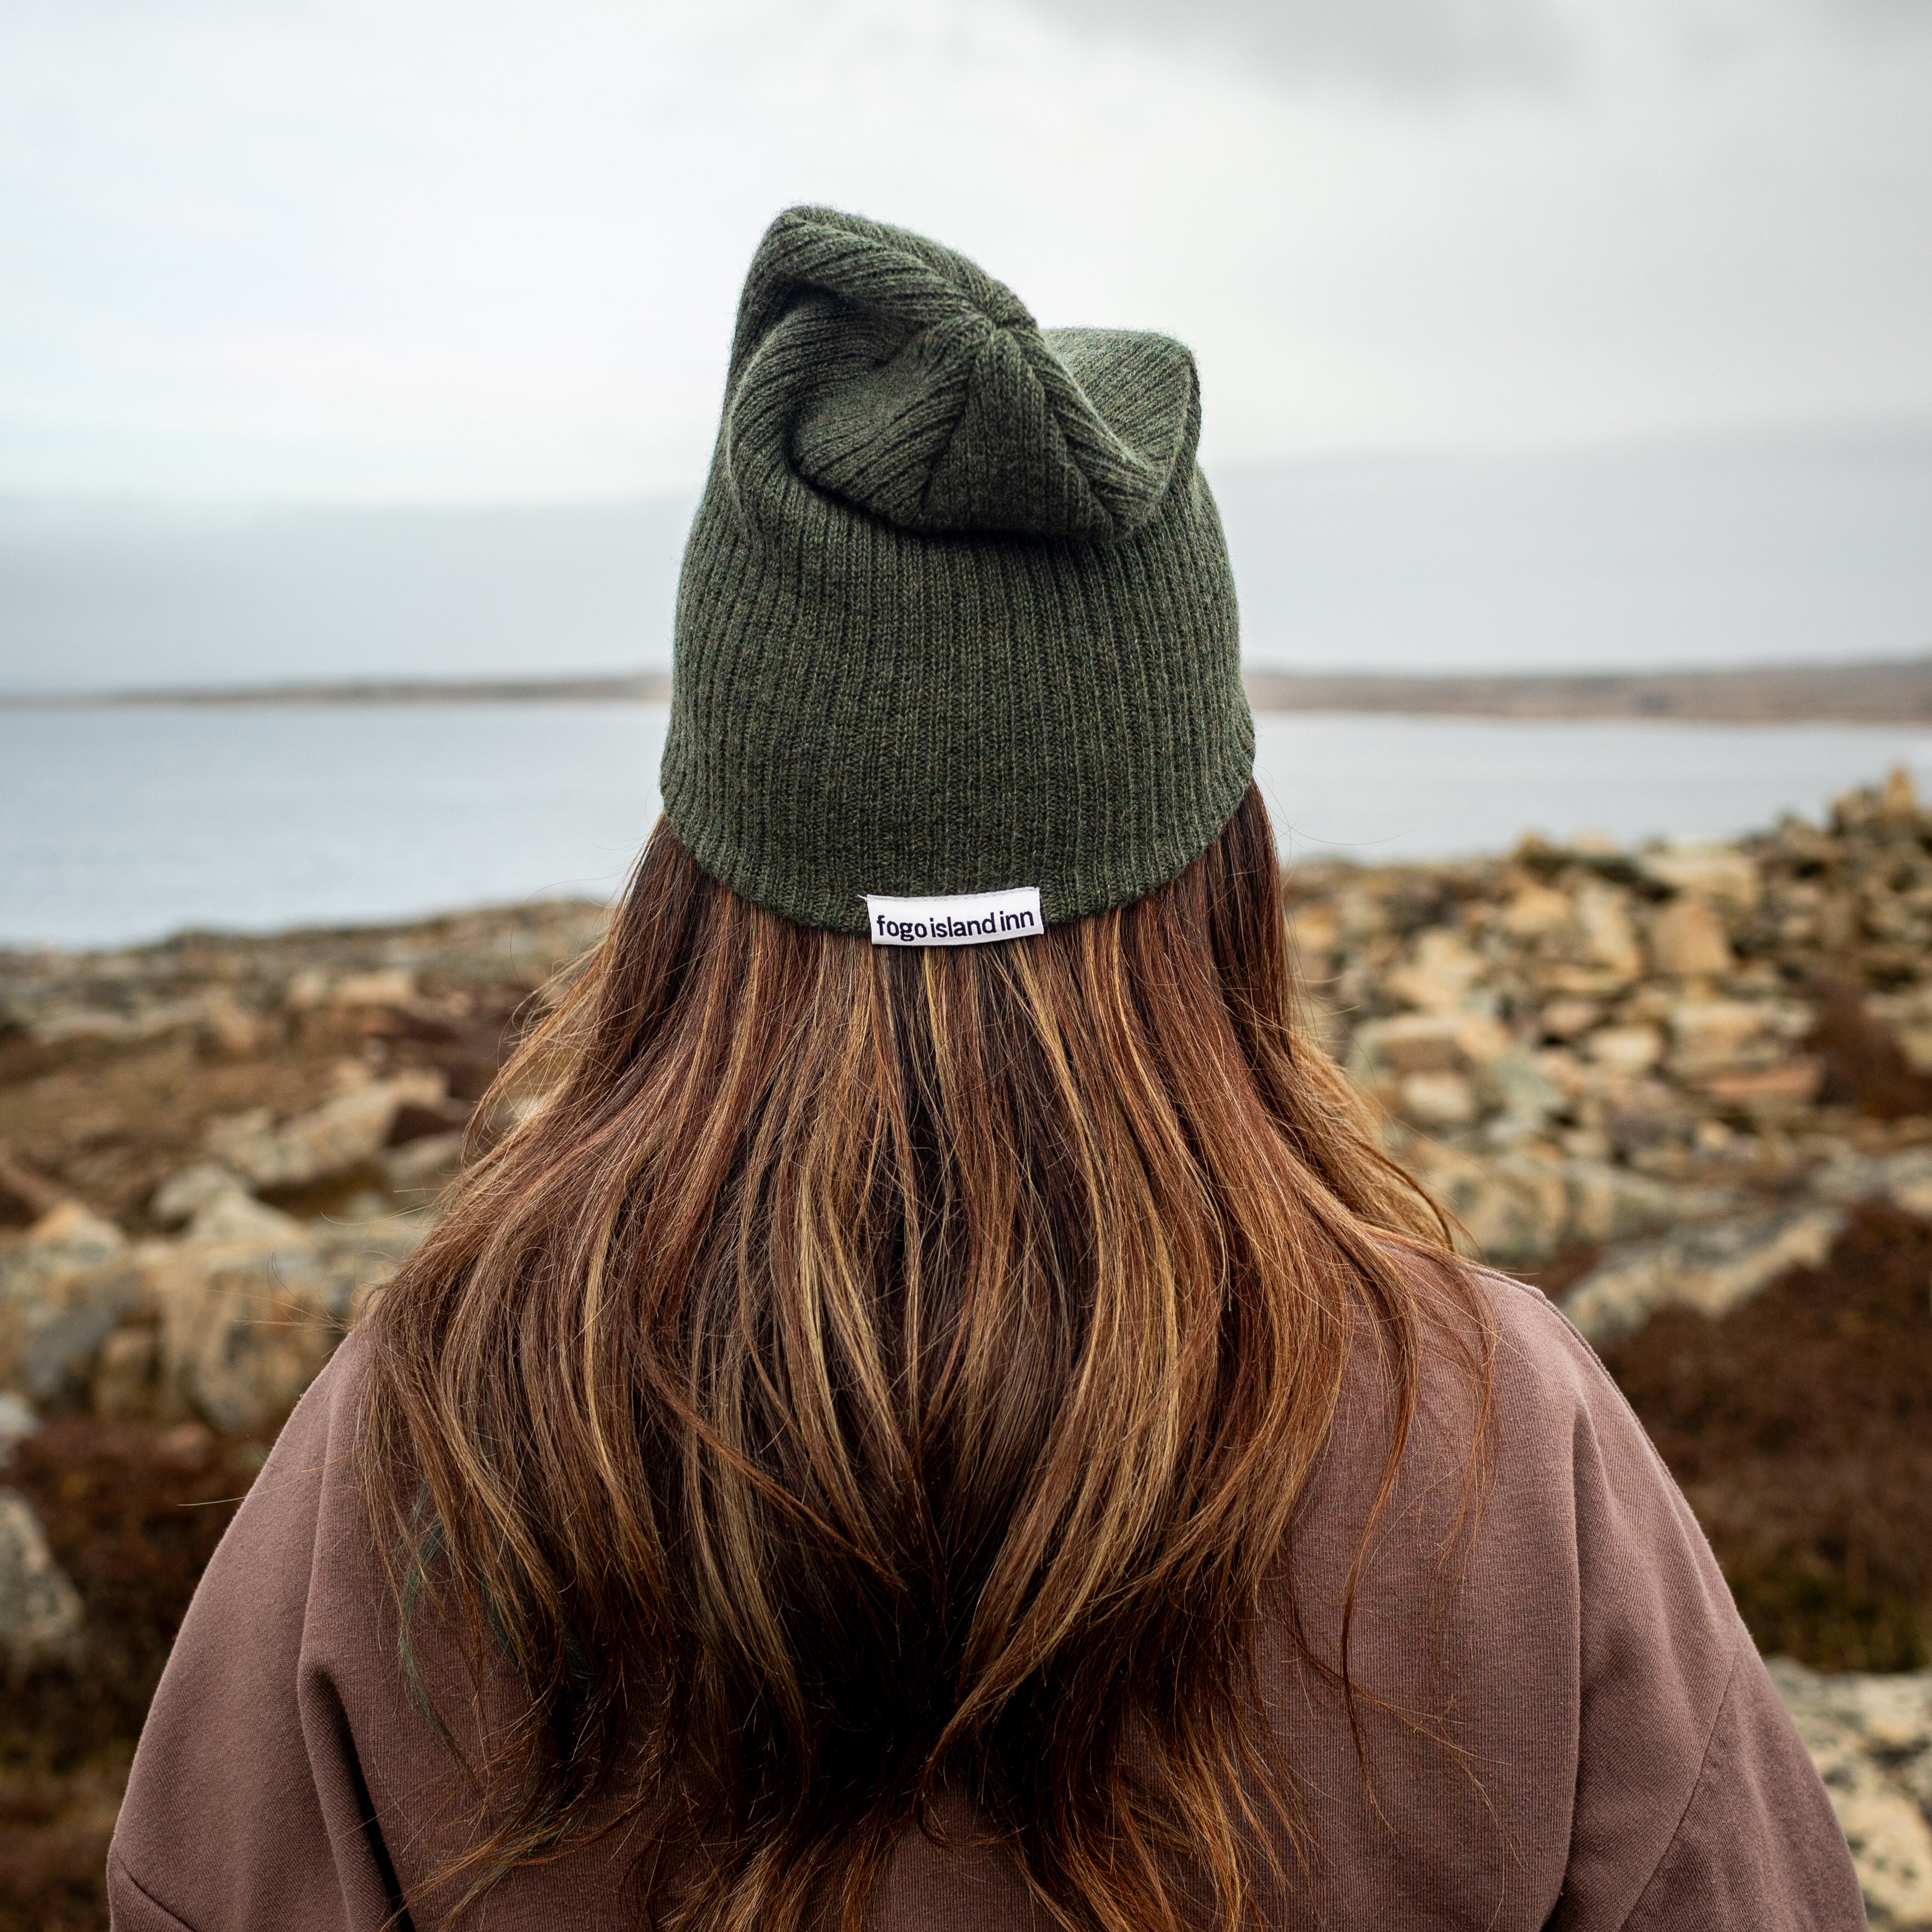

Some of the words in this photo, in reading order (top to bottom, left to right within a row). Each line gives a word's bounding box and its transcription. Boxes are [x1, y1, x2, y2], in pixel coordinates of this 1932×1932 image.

[876, 915, 928, 942] fogo
[929, 912, 997, 938] island
[999, 911, 1035, 932] inn
